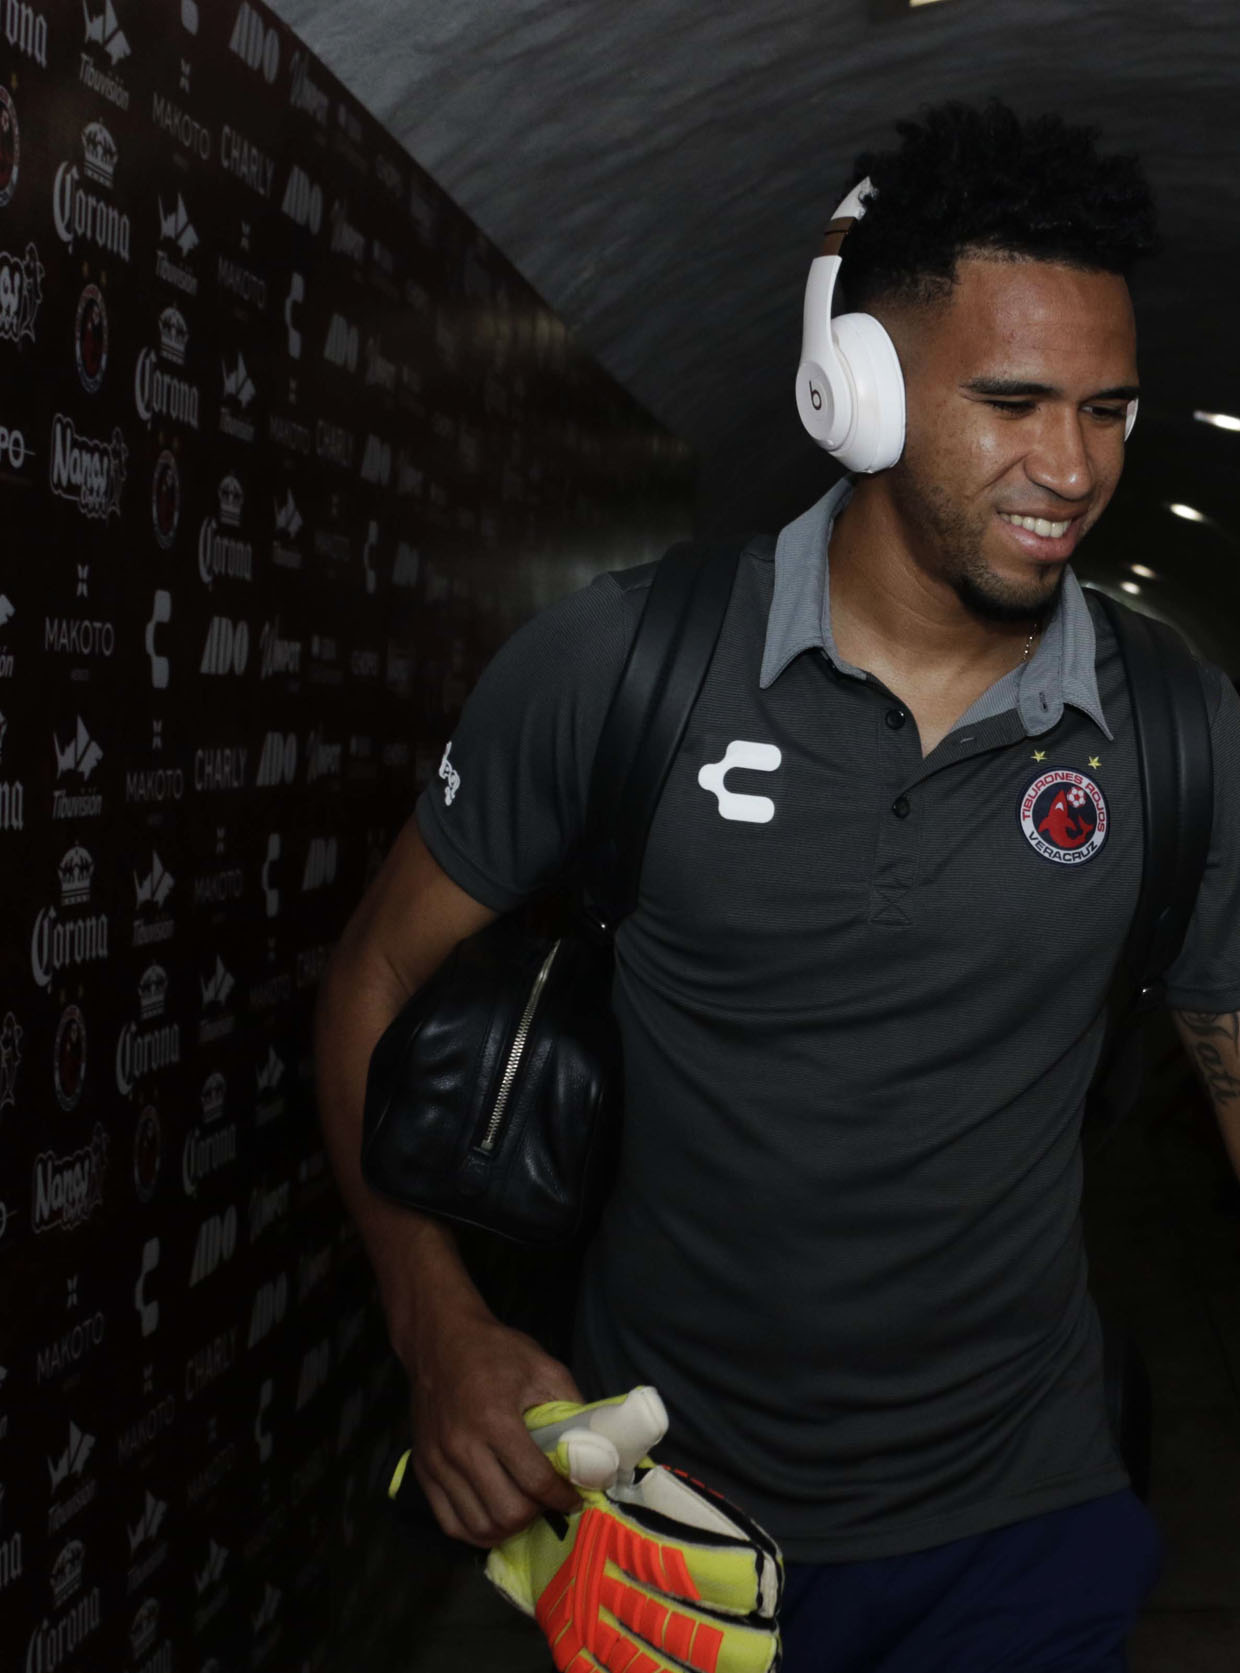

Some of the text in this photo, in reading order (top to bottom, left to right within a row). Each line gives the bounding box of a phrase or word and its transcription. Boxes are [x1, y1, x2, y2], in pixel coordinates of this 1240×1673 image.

[152, 91, 210, 161] MAKOTO
[220, 124, 275, 199] CHARLY
[53, 161, 131, 263] Corona
[134, 346, 200, 431] Corona
[199, 515, 253, 592] Corona
[44, 616, 115, 657] MAKOTO
[126, 768, 184, 802] MAKOTO
[194, 746, 248, 792] CHARLY
[1022, 772, 1107, 832] TIBURONES ROJOS
[1028, 831, 1098, 862] VERACRUZ
[31, 905, 110, 994] Corona
[115, 1018, 181, 1101] Corona
[36, 1311, 105, 1384] MAKOTO
